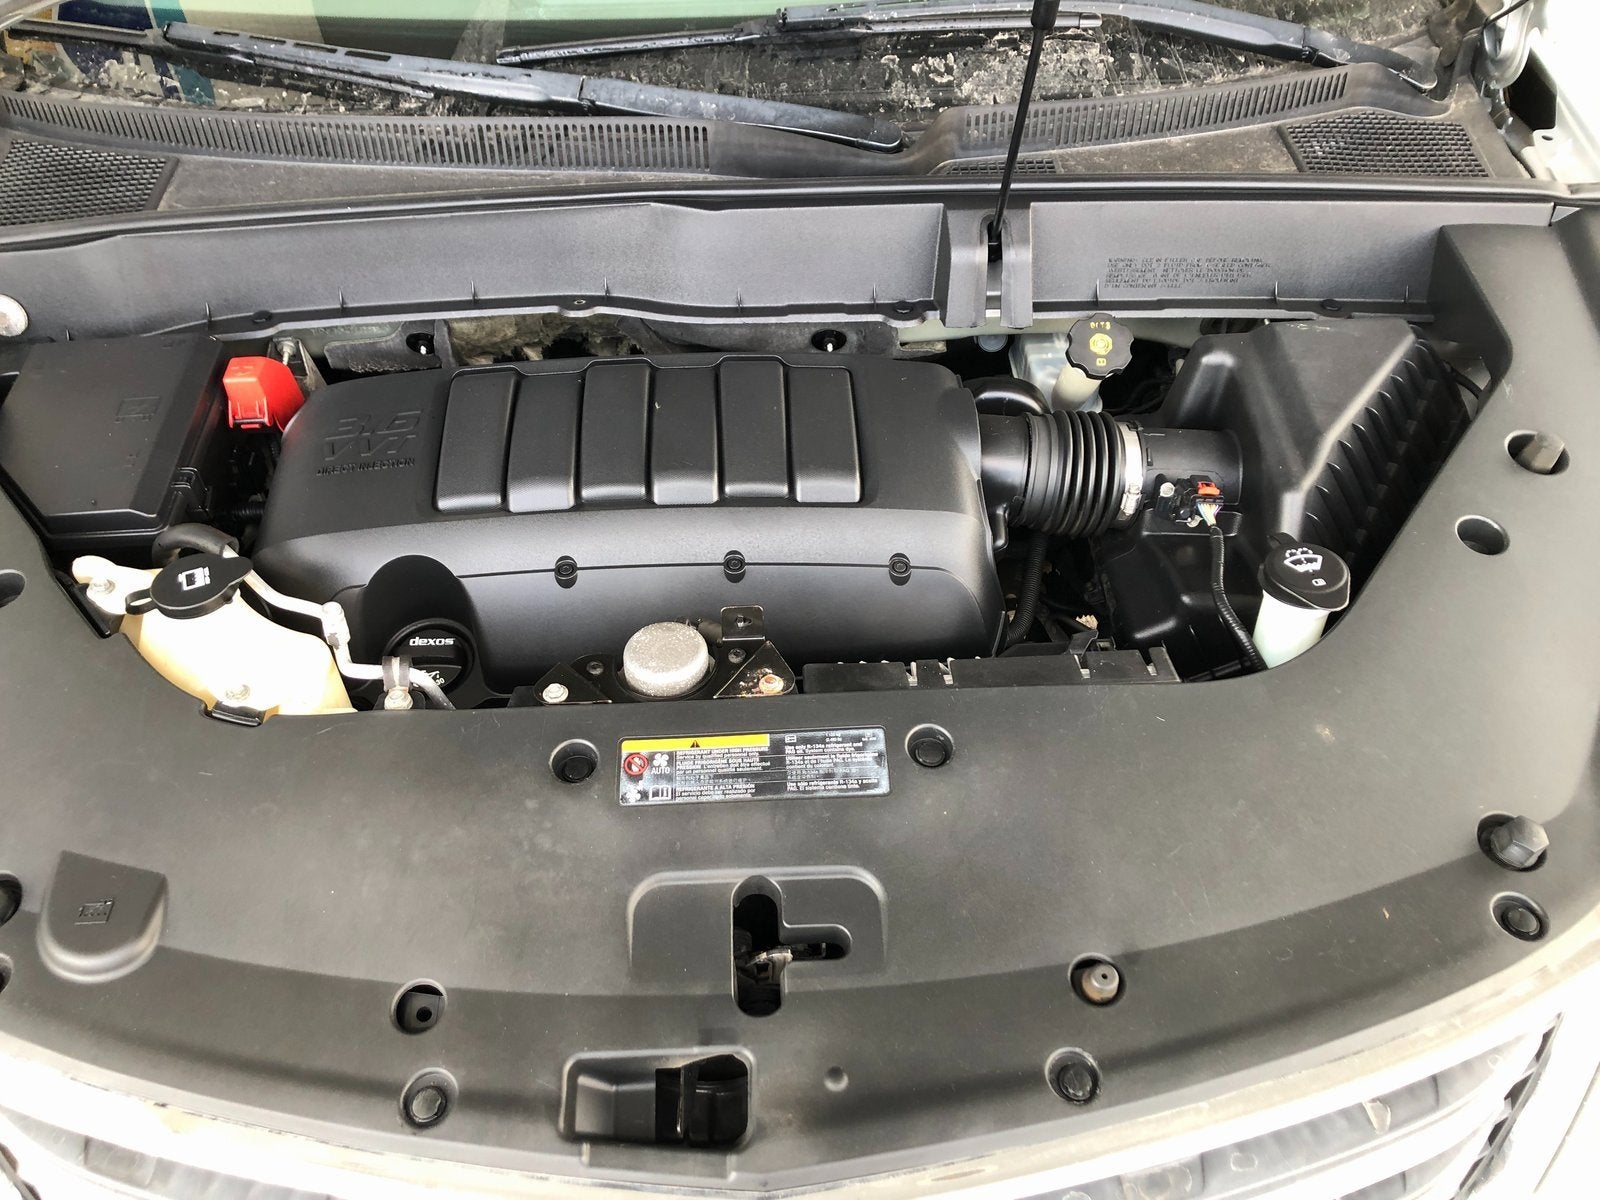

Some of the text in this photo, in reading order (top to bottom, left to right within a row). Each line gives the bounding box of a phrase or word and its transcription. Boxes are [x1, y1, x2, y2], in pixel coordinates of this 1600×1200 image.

[316, 457, 416, 477] DIRECT INJECTION
[409, 636, 454, 646] dexos
[651, 766, 670, 775] AUTO
